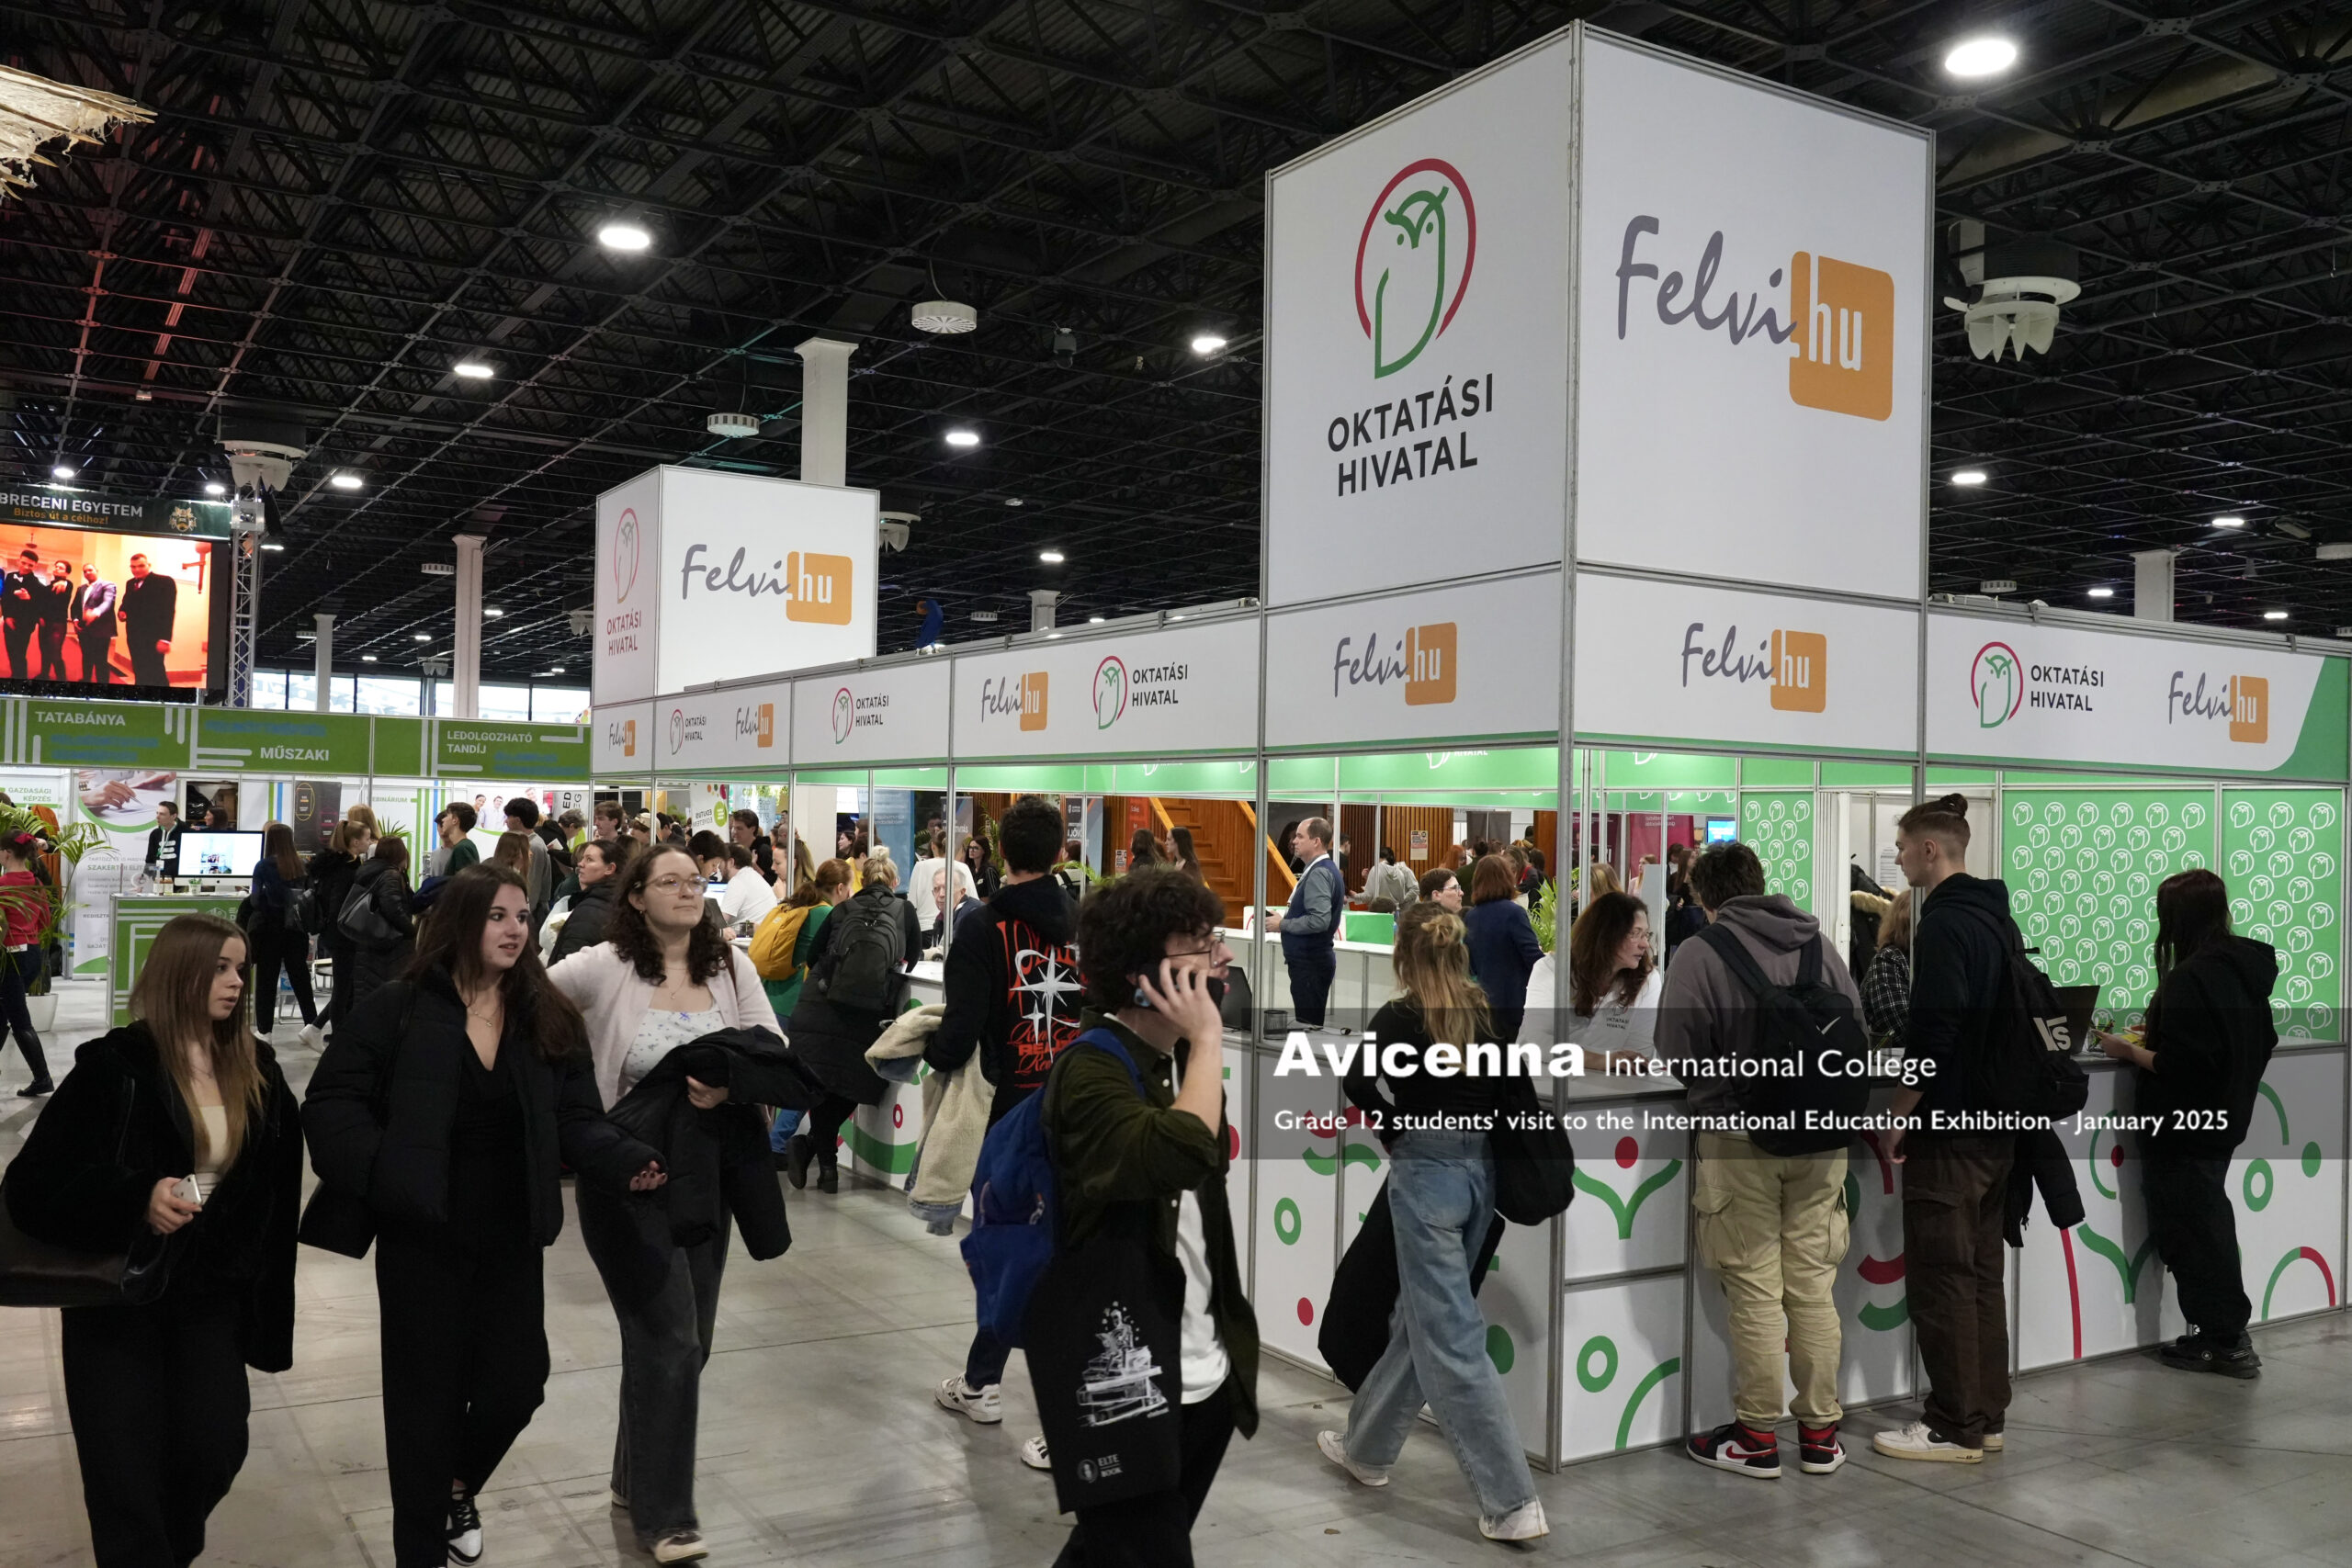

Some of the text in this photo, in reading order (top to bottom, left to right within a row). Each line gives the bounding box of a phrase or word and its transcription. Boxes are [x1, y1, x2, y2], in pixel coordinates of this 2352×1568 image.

[1328, 373, 1493, 452] OKTATÁSI
[1338, 431, 1478, 497] HIVATAL
[14, 507, 46, 519] Biztos
[49, 510, 60, 521] út
[71, 513, 109, 525] célhoz!
[72, 500, 143, 518] EGYETEM
[606, 608, 642, 636] OKTATÁSI
[608, 636, 638, 656] HIVATAL
[1132, 663, 1188, 684] OKTATÁSI
[2030, 665, 2104, 688] OKTATÁSI
[855, 694, 889, 709] OKTATÁSI
[1132, 688, 1179, 707] HIVATAL
[2030, 691, 2093, 712] HIVATAL
[35, 711, 126, 726] TATABÁNYA
[684, 716, 707, 728] OKTATÁSI
[855, 713, 884, 728] HIVATAL
[447, 730, 533, 743] LEDOLGOZHATÓ
[684, 731, 703, 741] HIVATAL
[260, 745, 329, 761] MŰSZAKI
[447, 743, 487, 754] TANDÍJ
[8, 786, 51, 795] GAZDASÁGI
[1097, 1453, 1120, 1467] ELTE
